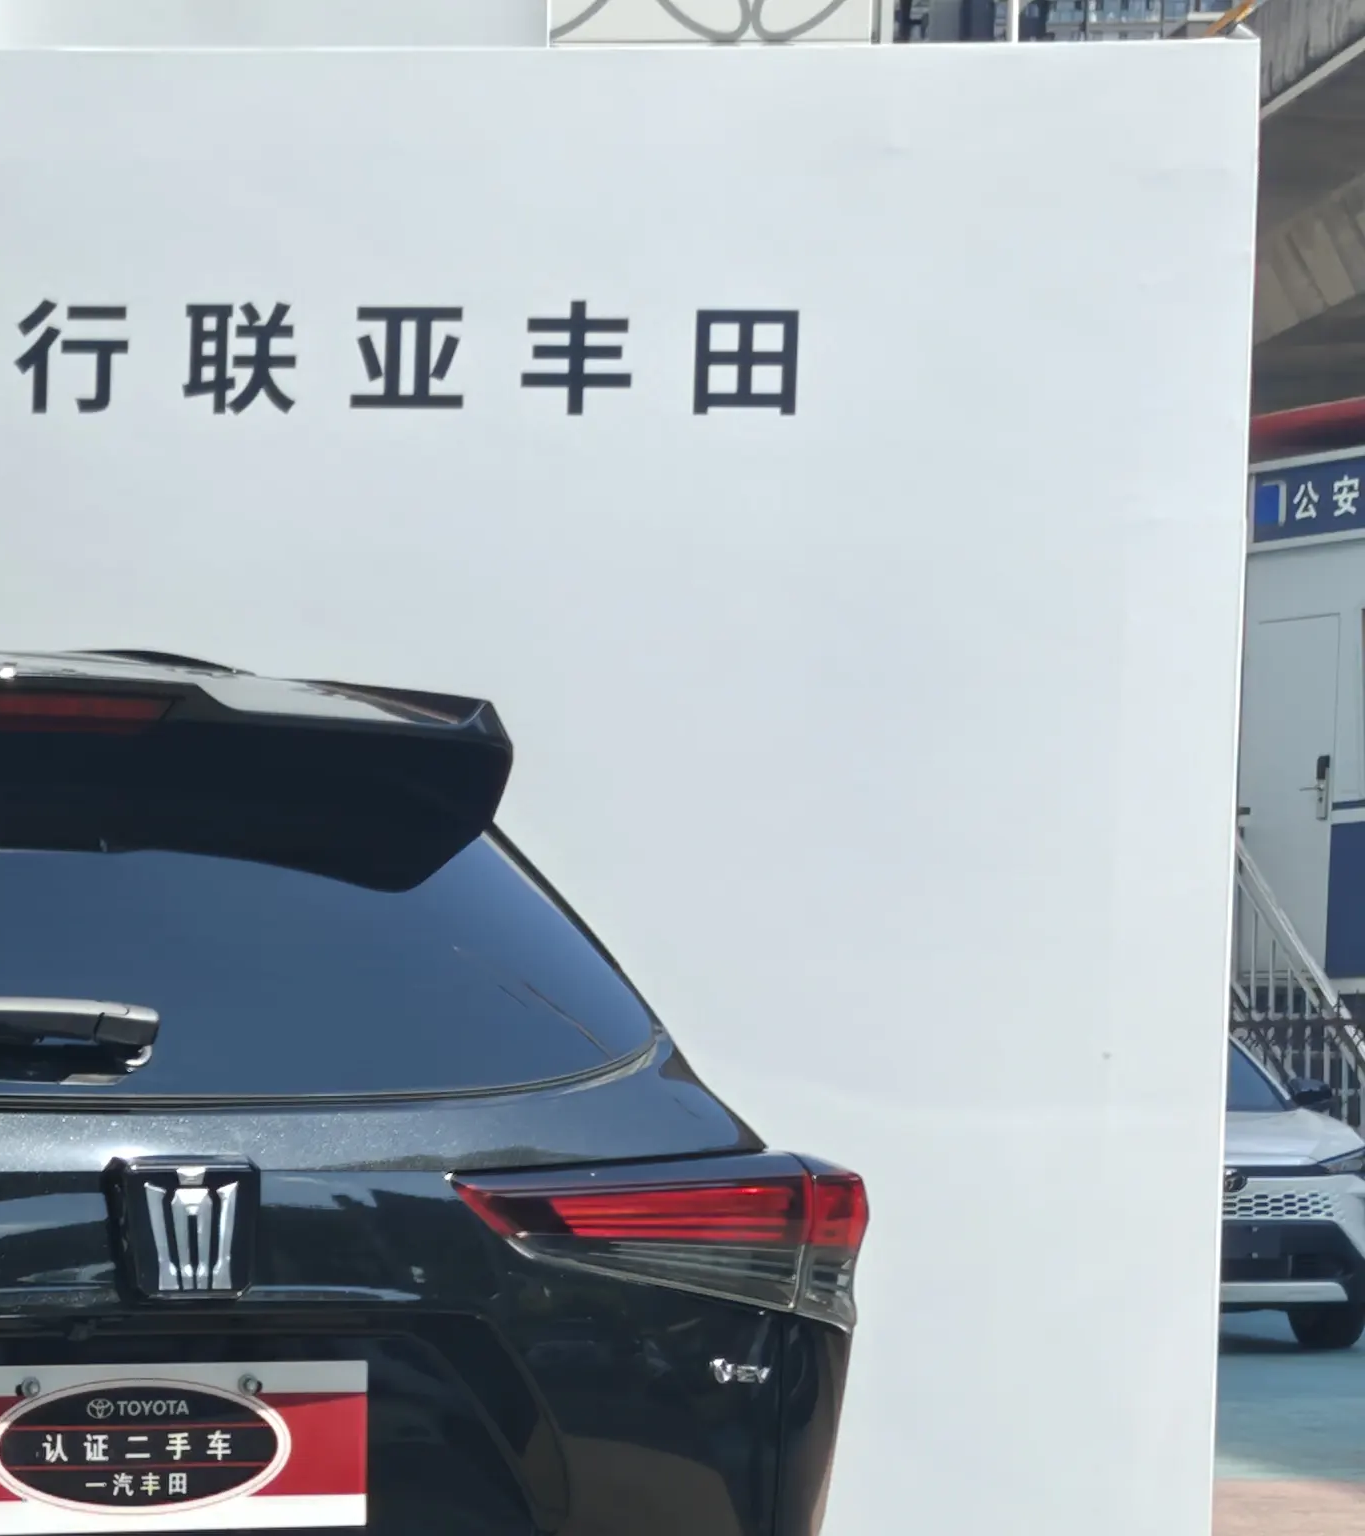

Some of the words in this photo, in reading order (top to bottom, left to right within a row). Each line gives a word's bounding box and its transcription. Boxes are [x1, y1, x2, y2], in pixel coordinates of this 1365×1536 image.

[1292, 474, 1360, 520] 公安
[117, 1400, 189, 1416] TOYOTA
[42, 1430, 231, 1463] 认证二手车
[85, 1472, 187, 1497] 一汽丰田
